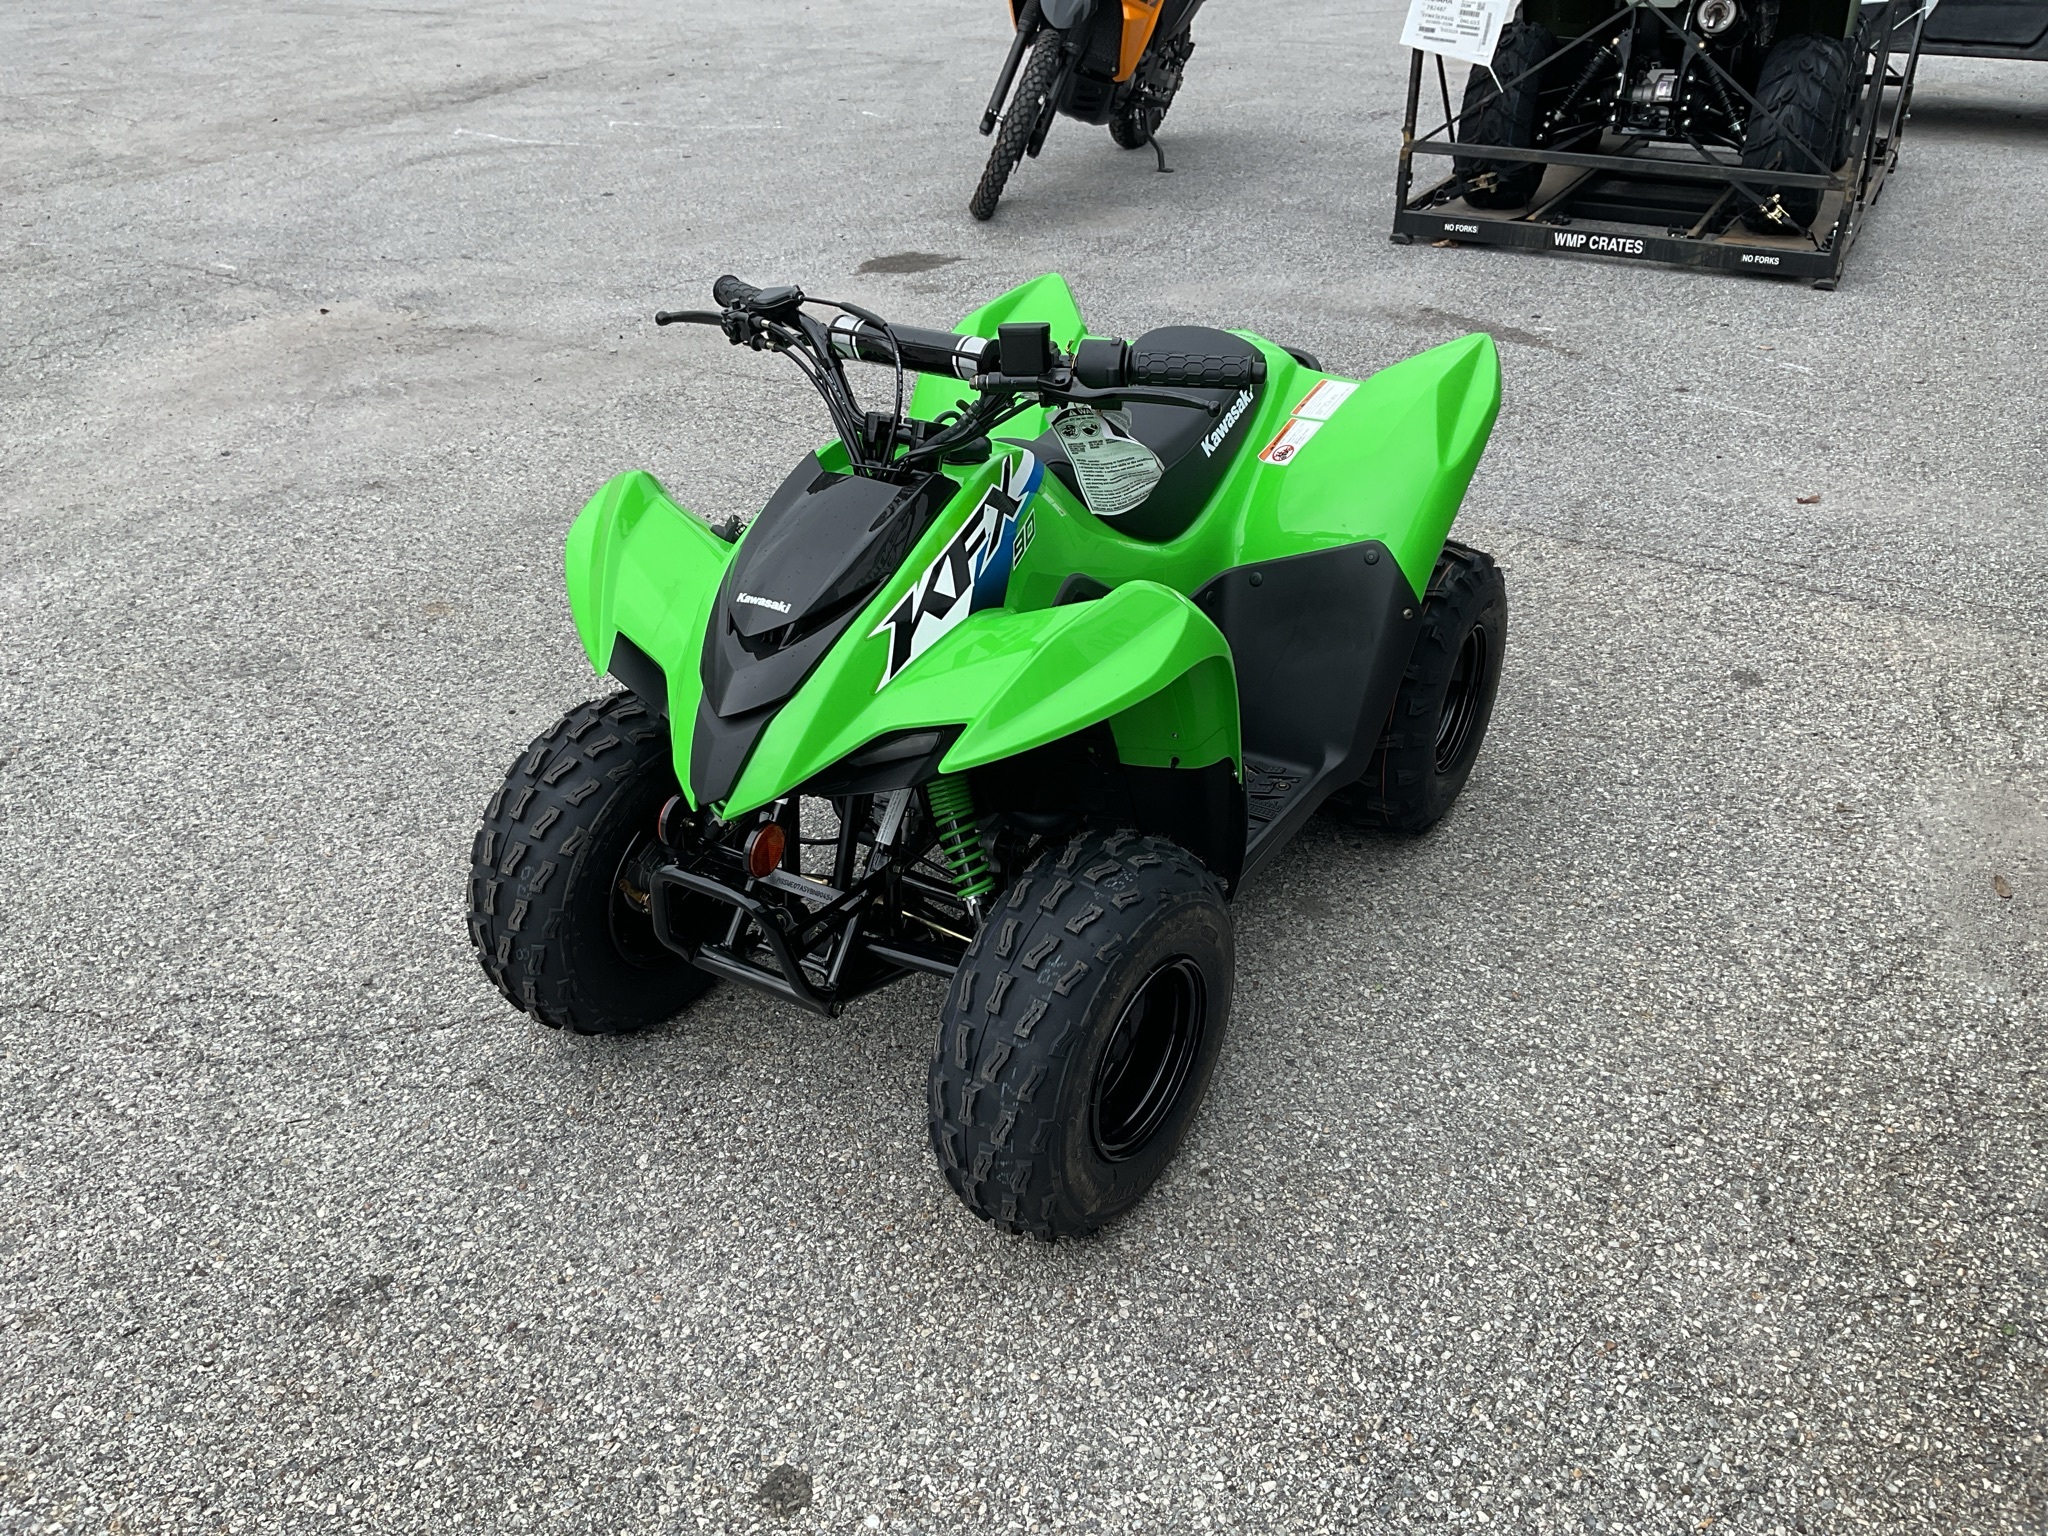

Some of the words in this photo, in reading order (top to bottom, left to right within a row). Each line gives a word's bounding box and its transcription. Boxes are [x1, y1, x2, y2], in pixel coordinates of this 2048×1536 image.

[1444, 223, 1454, 231] NO
[1455, 224, 1477, 234] FORKS
[1554, 232, 1587, 248] WMP
[1588, 235, 1644, 254] CRATES
[1742, 254, 1754, 263] NO
[1754, 255, 1780, 266] FORKS
[872, 453, 1028, 690] KFX
[736, 592, 792, 614] Kawasaki
